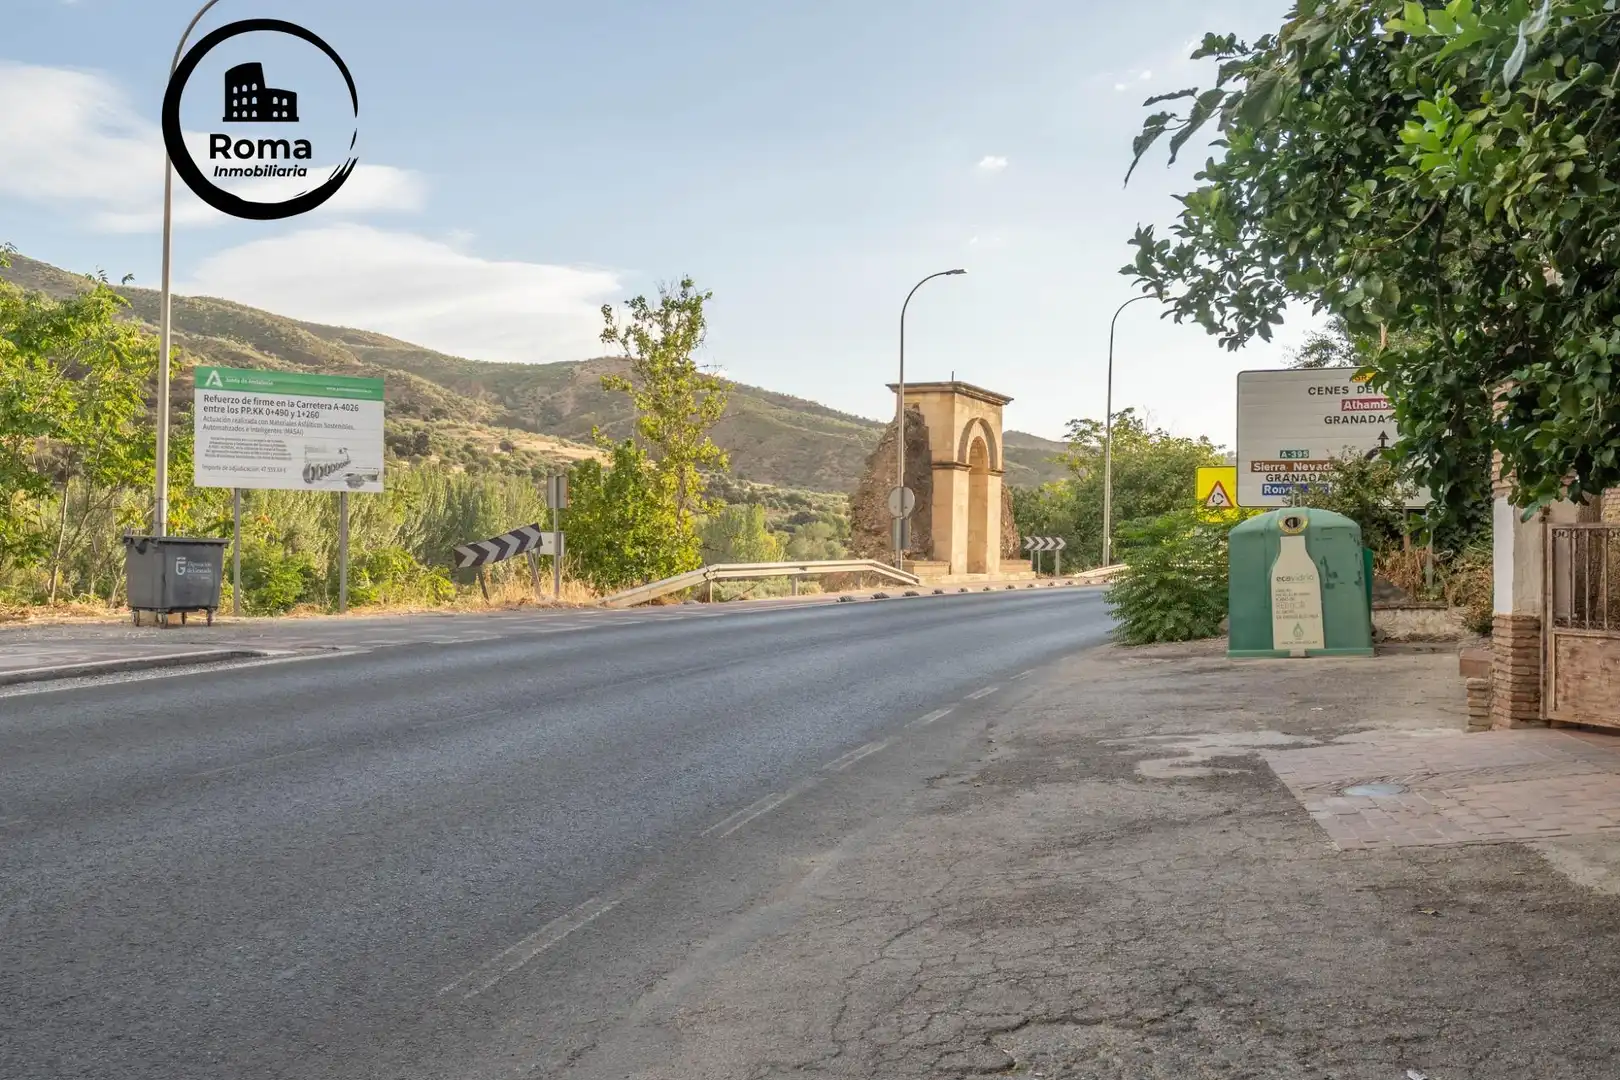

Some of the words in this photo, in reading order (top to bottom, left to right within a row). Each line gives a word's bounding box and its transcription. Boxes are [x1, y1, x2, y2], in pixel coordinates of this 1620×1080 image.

[1307, 385, 1349, 396] CENES
[1356, 385, 1372, 394] DE
[203, 394, 240, 404] Refuerzo
[241, 396, 252, 405] de
[253, 397, 275, 407] firme
[287, 399, 295, 408] la
[296, 400, 332, 410] Carretera
[333, 403, 360, 412] A-4026
[1343, 399, 1389, 411] Alhamb
[203, 405, 226, 414] entre
[227, 405, 240, 415] los
[240, 406, 264, 416] PP.KK
[265, 408, 289, 417] 0+490
[290, 411, 296, 419] y
[297, 410, 320, 419] 1+260
[202, 415, 231, 423] Actuación
[232, 417, 258, 425] realizada
[269, 419, 297, 428] Materiales
[1324, 414, 1386, 425] GRANADA
[202, 424, 245, 432] Automatizados
[1281, 450, 1309, 459] A-395
[1253, 462, 1286, 472] Sierra
